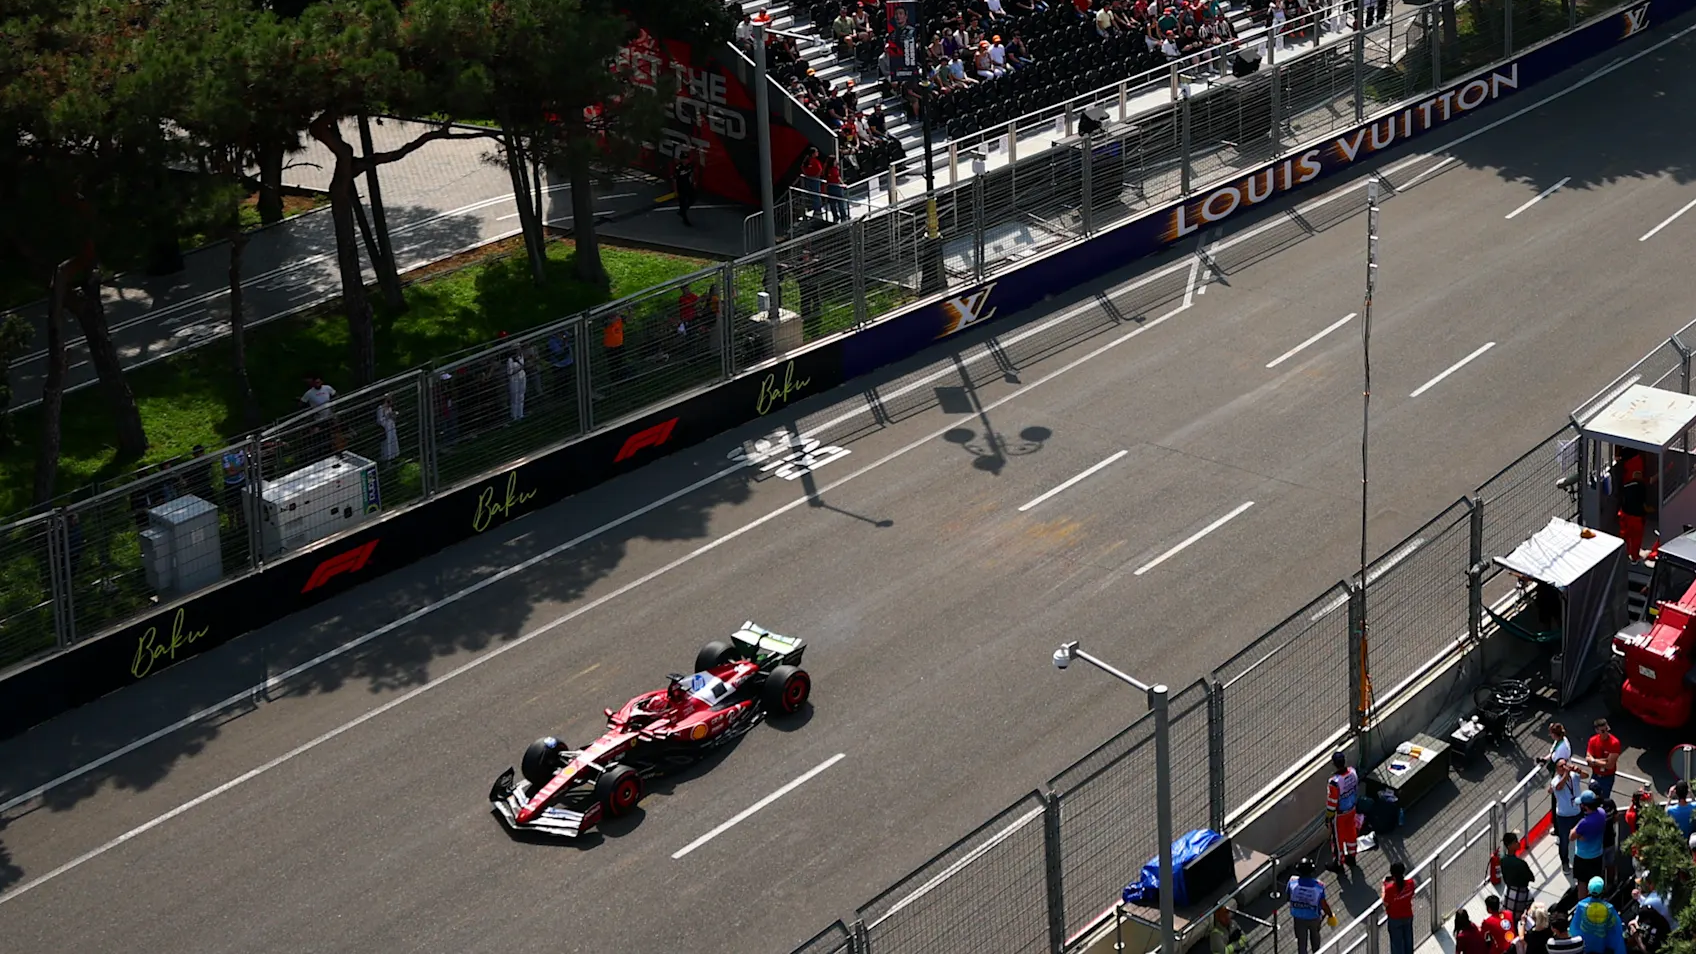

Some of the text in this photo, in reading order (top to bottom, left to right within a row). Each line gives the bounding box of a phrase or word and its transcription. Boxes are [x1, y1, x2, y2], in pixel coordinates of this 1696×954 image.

[668, 60, 728, 106] THE
[1177, 62, 1518, 237] LOUIS VUITTON
[755, 359, 812, 416] Baku
[613, 416, 680, 463] F1
[471, 470, 538, 534] Baku
[300, 538, 380, 594] F1
[130, 607, 209, 679] Baku
